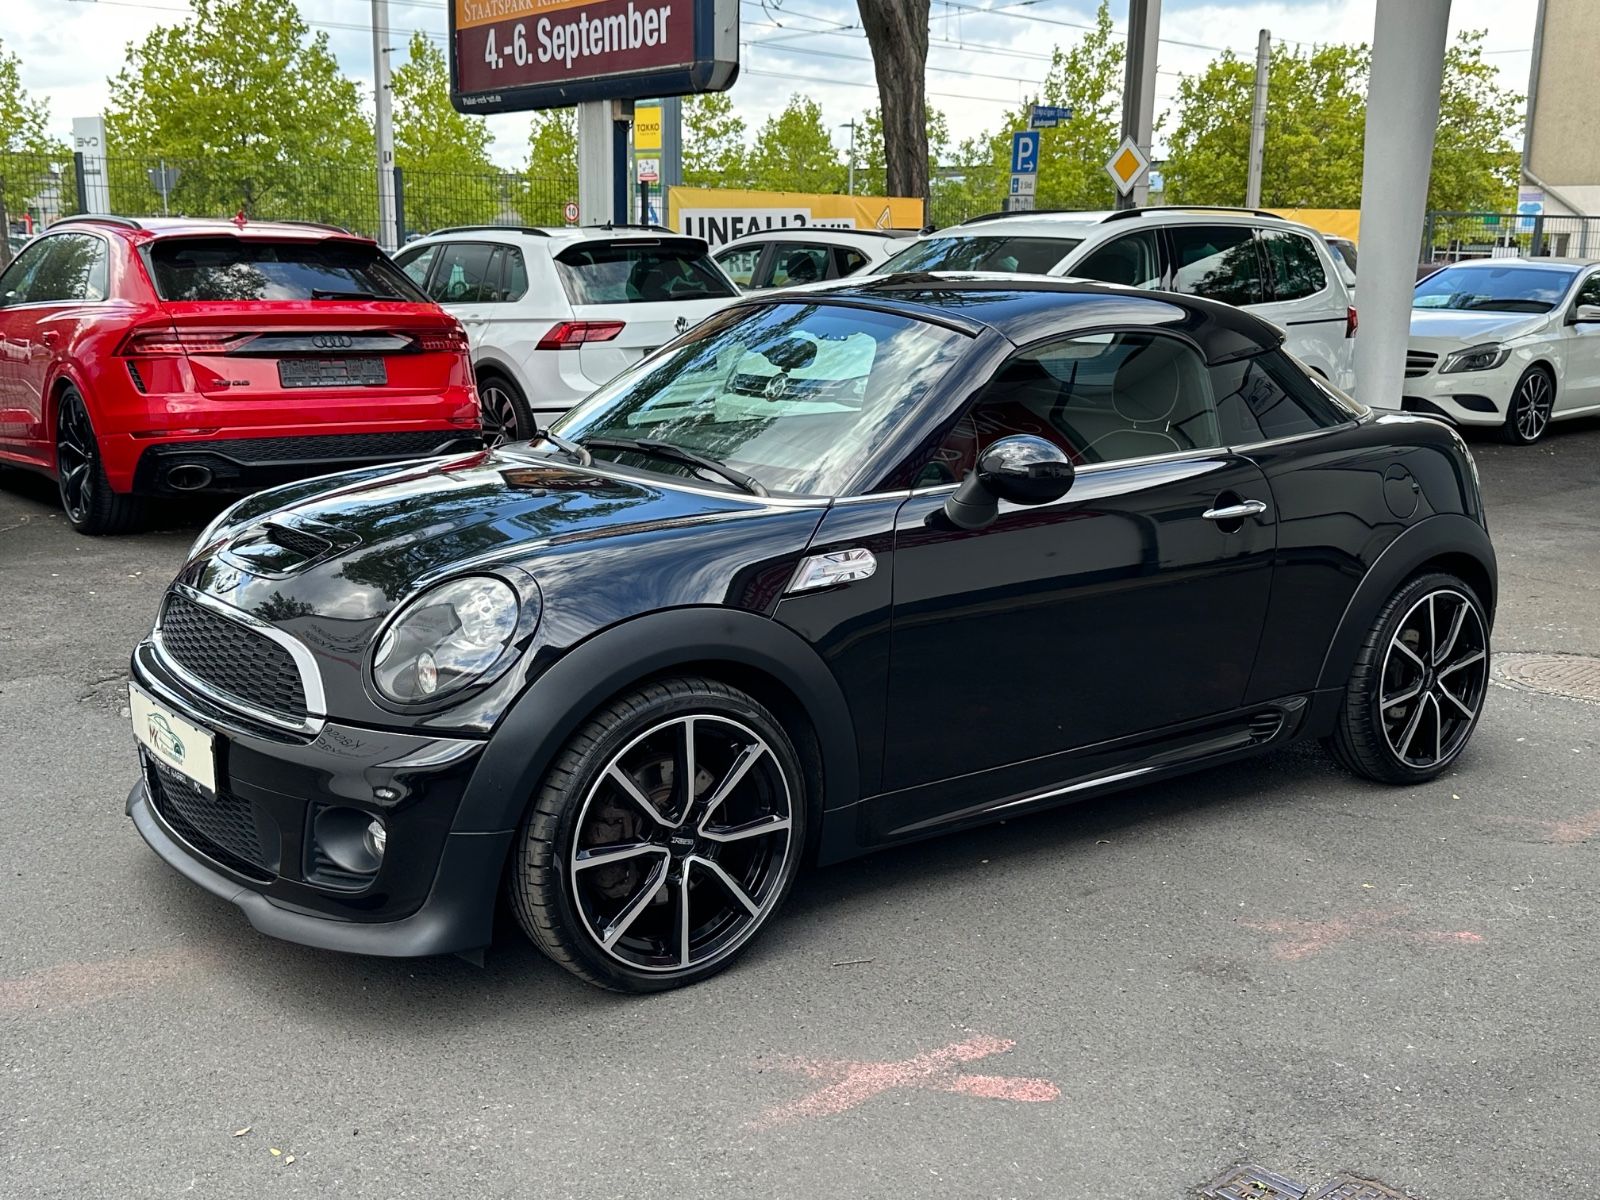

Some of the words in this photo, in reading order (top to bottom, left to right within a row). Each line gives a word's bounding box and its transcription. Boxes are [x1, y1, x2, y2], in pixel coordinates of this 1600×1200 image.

[484, 24, 533, 70] 4.-6.
[537, 2, 671, 68] September
[1017, 137, 1033, 171] P
[568, 207, 576, 217] 10
